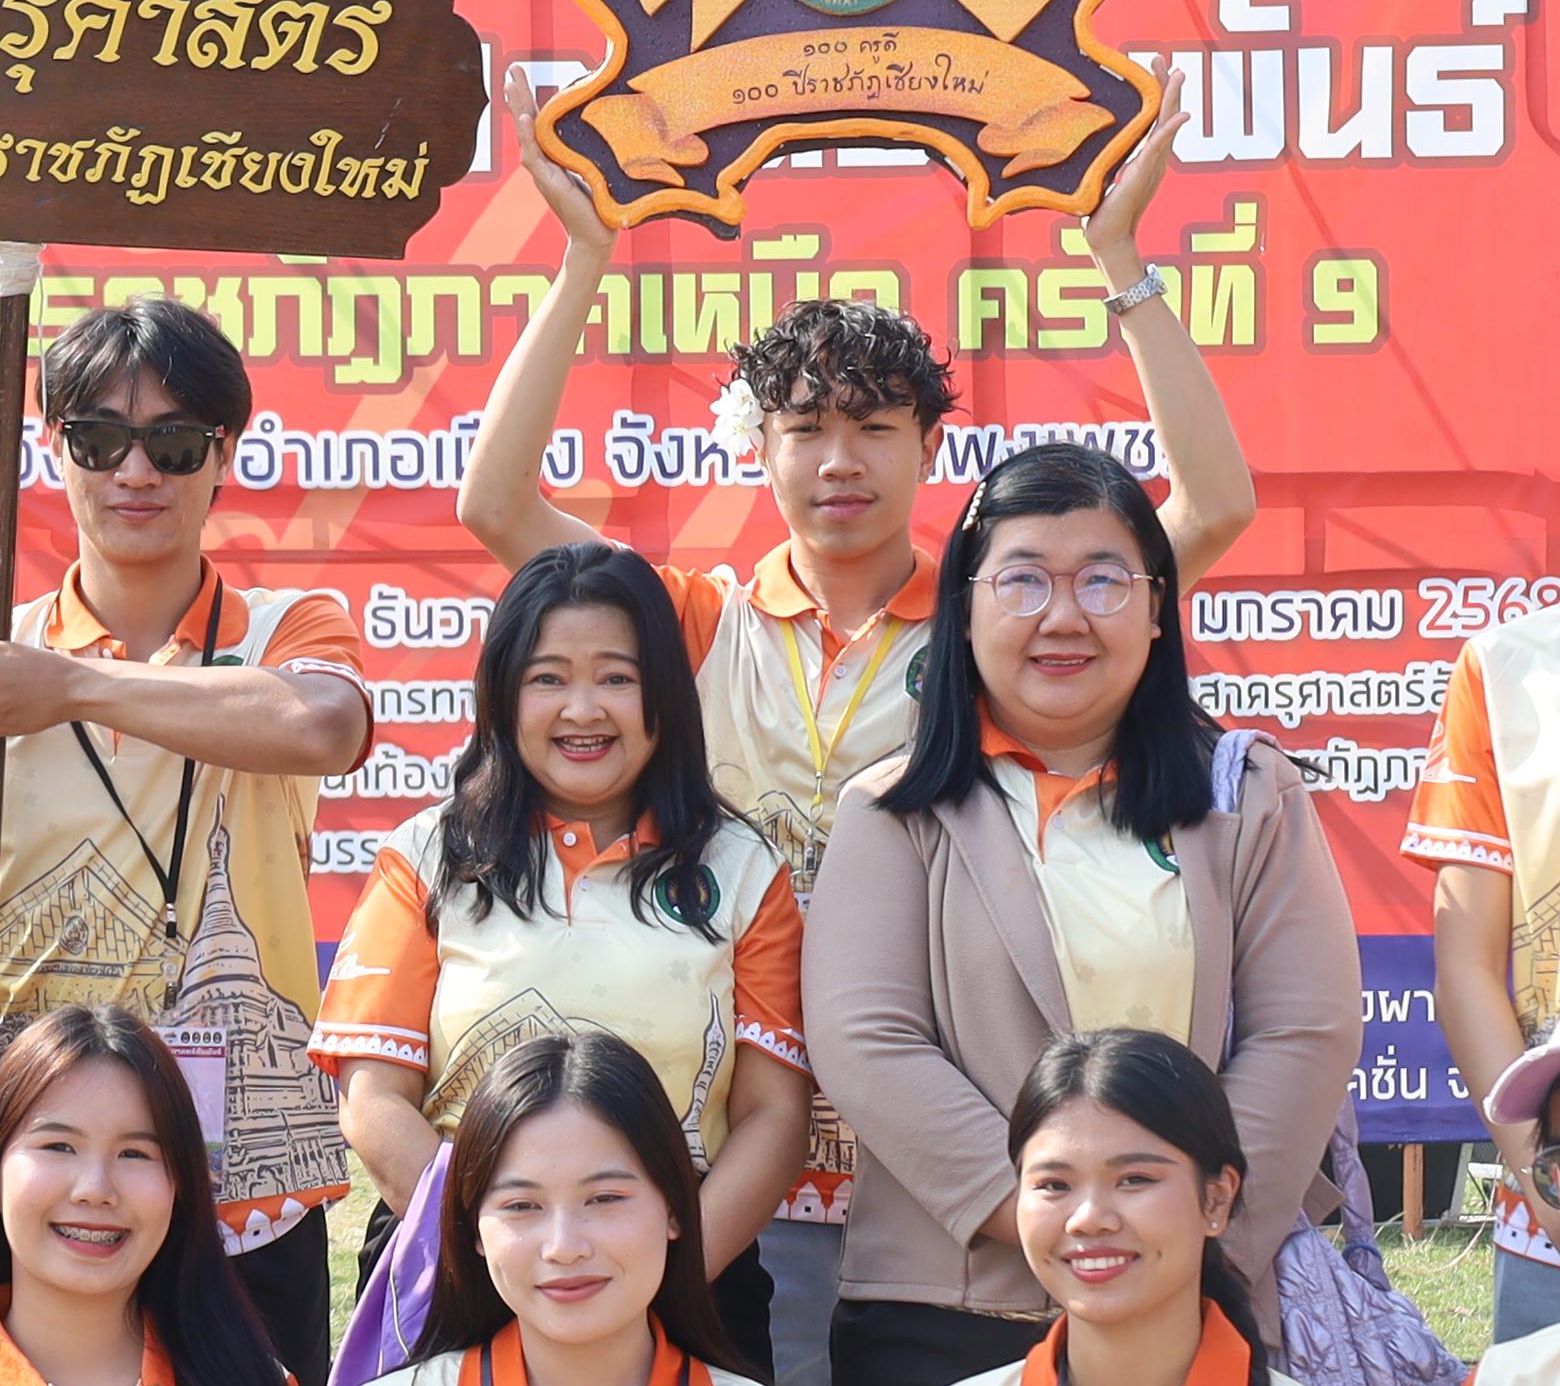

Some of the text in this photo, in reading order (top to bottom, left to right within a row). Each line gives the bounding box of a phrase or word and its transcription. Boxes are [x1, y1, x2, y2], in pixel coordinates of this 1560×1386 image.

[803, 31, 900, 63] ๑๐๐ ครูดี
[732, 53, 990, 104] ๑๐๐ ปีราชภัฏเชียงใหม่
[1312, 259, 1378, 345] 9
[1198, 592, 1398, 635] มกราคม
